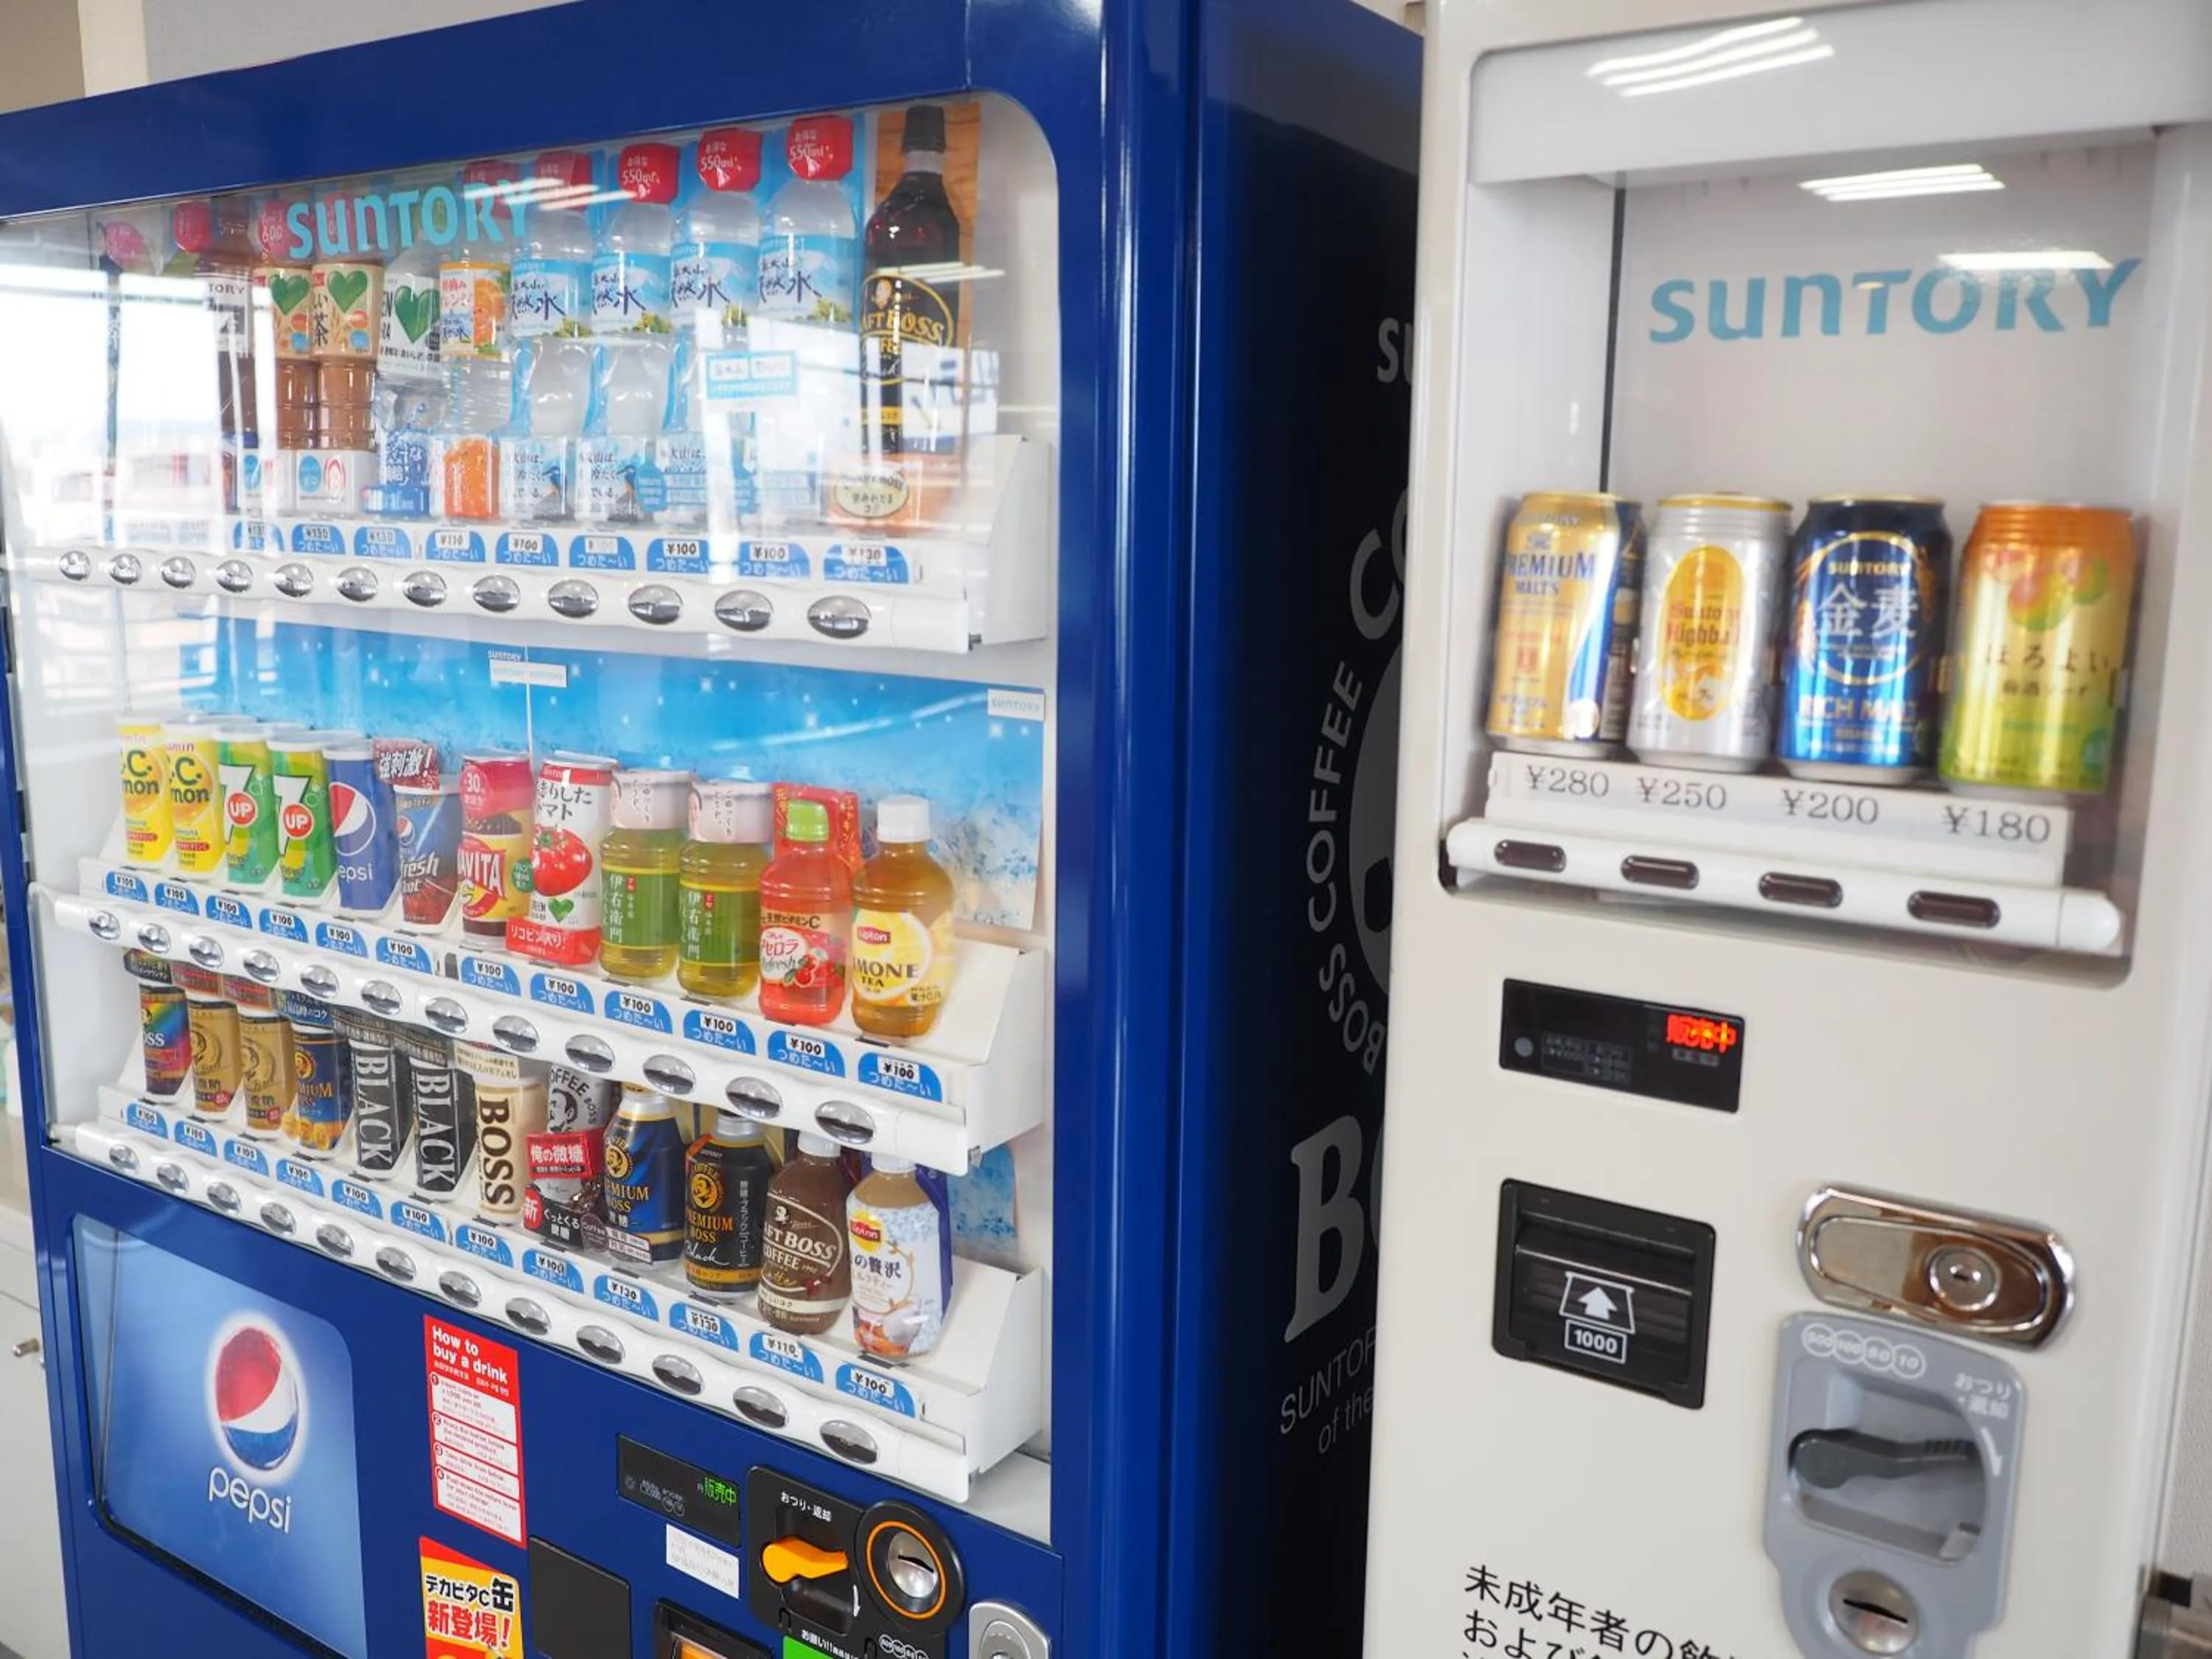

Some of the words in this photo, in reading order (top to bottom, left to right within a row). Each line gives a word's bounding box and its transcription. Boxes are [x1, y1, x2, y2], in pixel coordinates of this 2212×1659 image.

[286, 177, 540, 258] SUNTORY
[1649, 258, 2143, 344] SUNTORY
[667, 543, 697, 555] ¥100
[753, 546, 786, 560] ¥100
[1671, 602, 1741, 621] Sutoy
[1816, 582, 1920, 639] 金麦
[1526, 765, 1610, 799] ¥280
[1636, 777, 1728, 811] ¥250
[229, 801, 250, 818] UP
[1307, 661, 1365, 933] COFFEE
[1781, 789, 1879, 825] ¥200
[285, 813, 308, 830] UP
[1944, 806, 2052, 844] ¥180
[338, 863, 374, 883] epsi
[456, 847, 506, 900] AVITA
[329, 928, 350, 942] ¥100
[390, 941, 412, 955] ¥100
[477, 962, 501, 977] ¥100
[853, 956, 921, 979] IMONE
[548, 978, 574, 995] ¥100
[861, 975, 884, 987] TEA
[623, 997, 652, 1014] ¥100
[1319, 942, 1388, 1076] BOSS
[703, 1016, 734, 1033] ¥100
[789, 1037, 822, 1055] ¥100
[551, 1068, 590, 1097] OFFEE
[884, 1062, 914, 1079] ¥100
[297, 1081, 333, 1098] MIUM
[355, 1054, 393, 1165] BLACK
[416, 1073, 457, 1186] BLACK
[479, 1096, 515, 1206] BOSS
[345, 1186, 366, 1201] ¥100
[405, 1208, 428, 1223] ¥100
[784, 1231, 838, 1261] BOSS
[539, 1256, 566, 1273] ¥100
[850, 1253, 902, 1279] の贅沢
[612, 1281, 636, 1300] ¥130
[433, 1325, 461, 1350] How
[465, 1338, 479, 1357] to
[768, 1338, 796, 1354] ¥110
[1573, 1328, 1618, 1354] 1000
[433, 1340, 456, 1366] buy
[461, 1356, 470, 1369] a
[473, 1356, 509, 1385] drink
[1838, 1340, 1862, 1355] 100
[1899, 1354, 1919, 1369] 10
[854, 1371, 886, 1394] ¥100
[1280, 1326, 1377, 1435] SUNTO
[1955, 1371, 2011, 1399] おつり
[1318, 1407, 1340, 1455] of
[1343, 1386, 1374, 1433] the
[209, 1467, 293, 1534] pepsi
[1464, 1565, 1743, 1659] 未成年者の
[1463, 1610, 1601, 1659] および
